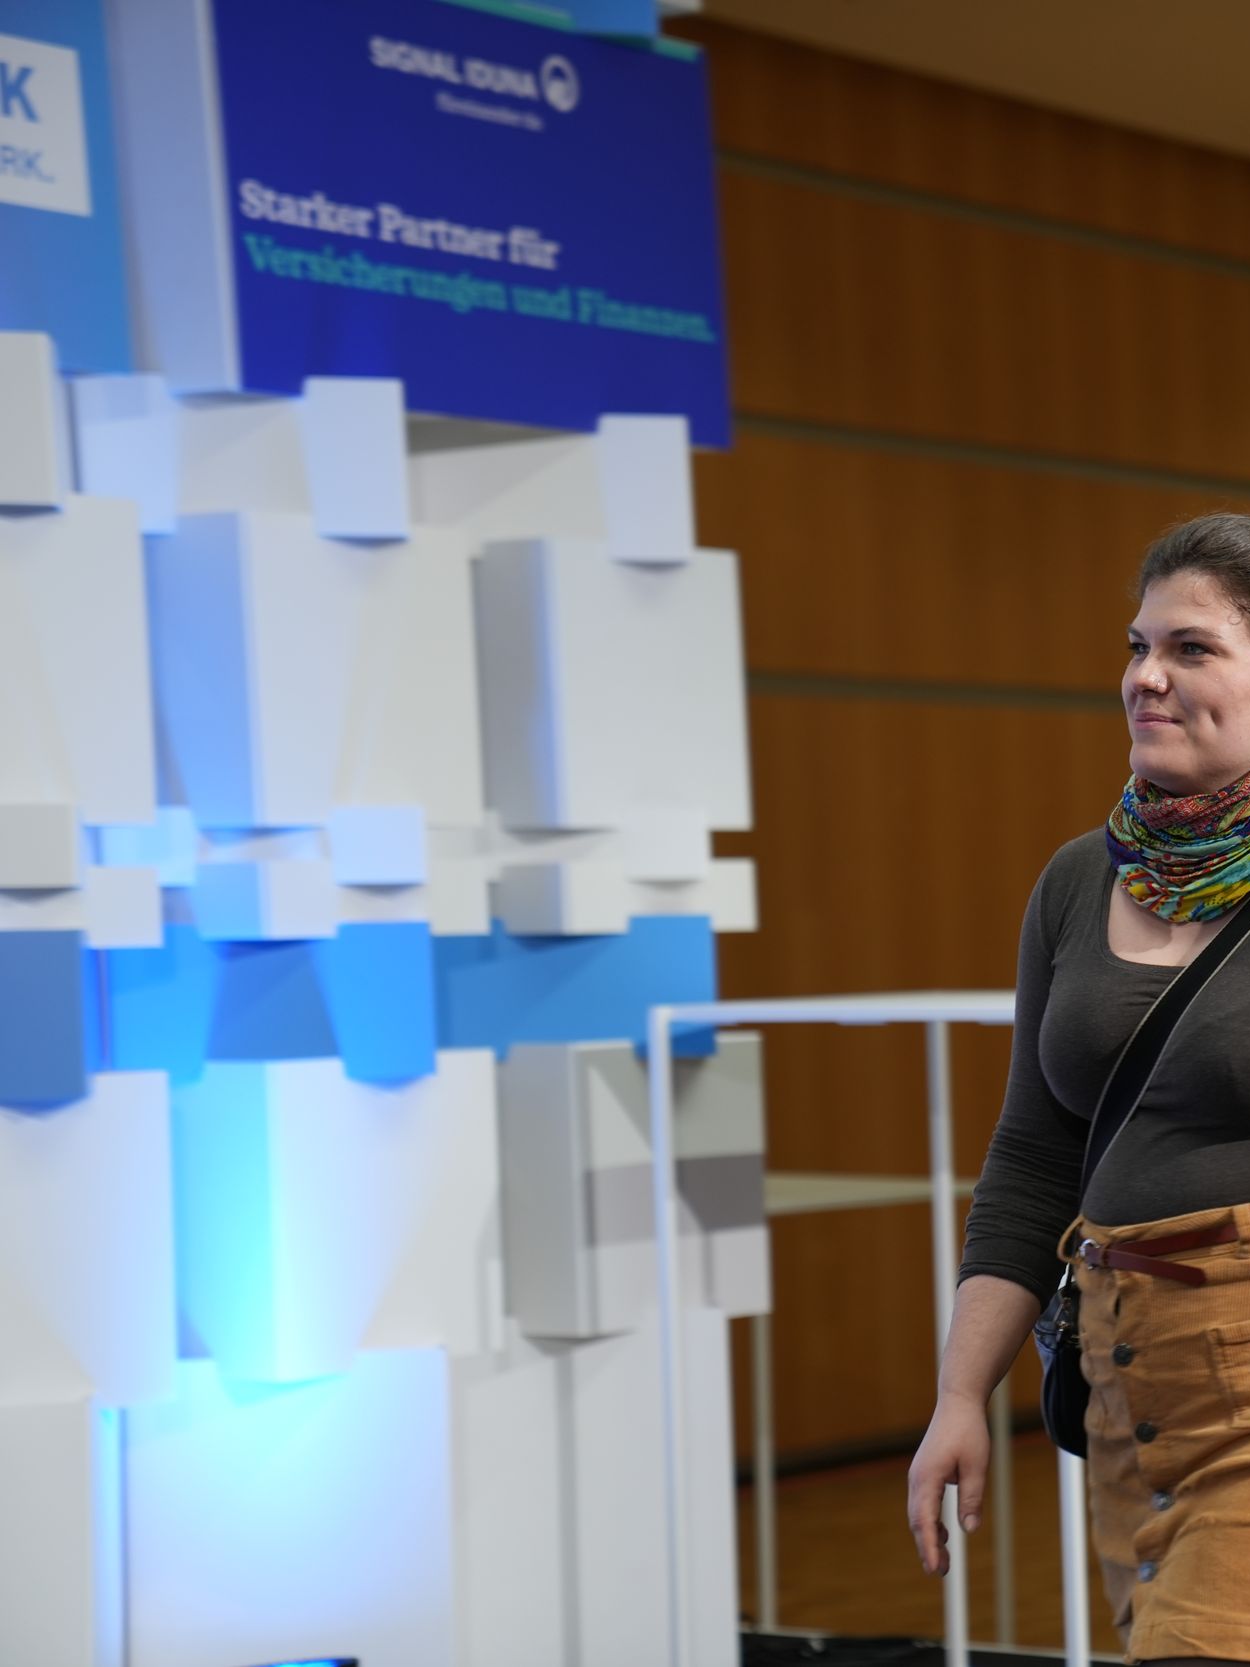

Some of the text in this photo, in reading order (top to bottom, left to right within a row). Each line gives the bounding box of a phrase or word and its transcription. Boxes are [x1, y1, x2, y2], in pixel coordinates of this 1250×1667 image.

[369, 36, 540, 100] SIGNAL IDUNA
[240, 179, 561, 270] Starker Partner für
[243, 233, 508, 313] Versicherungen
[511, 285, 572, 321] und
